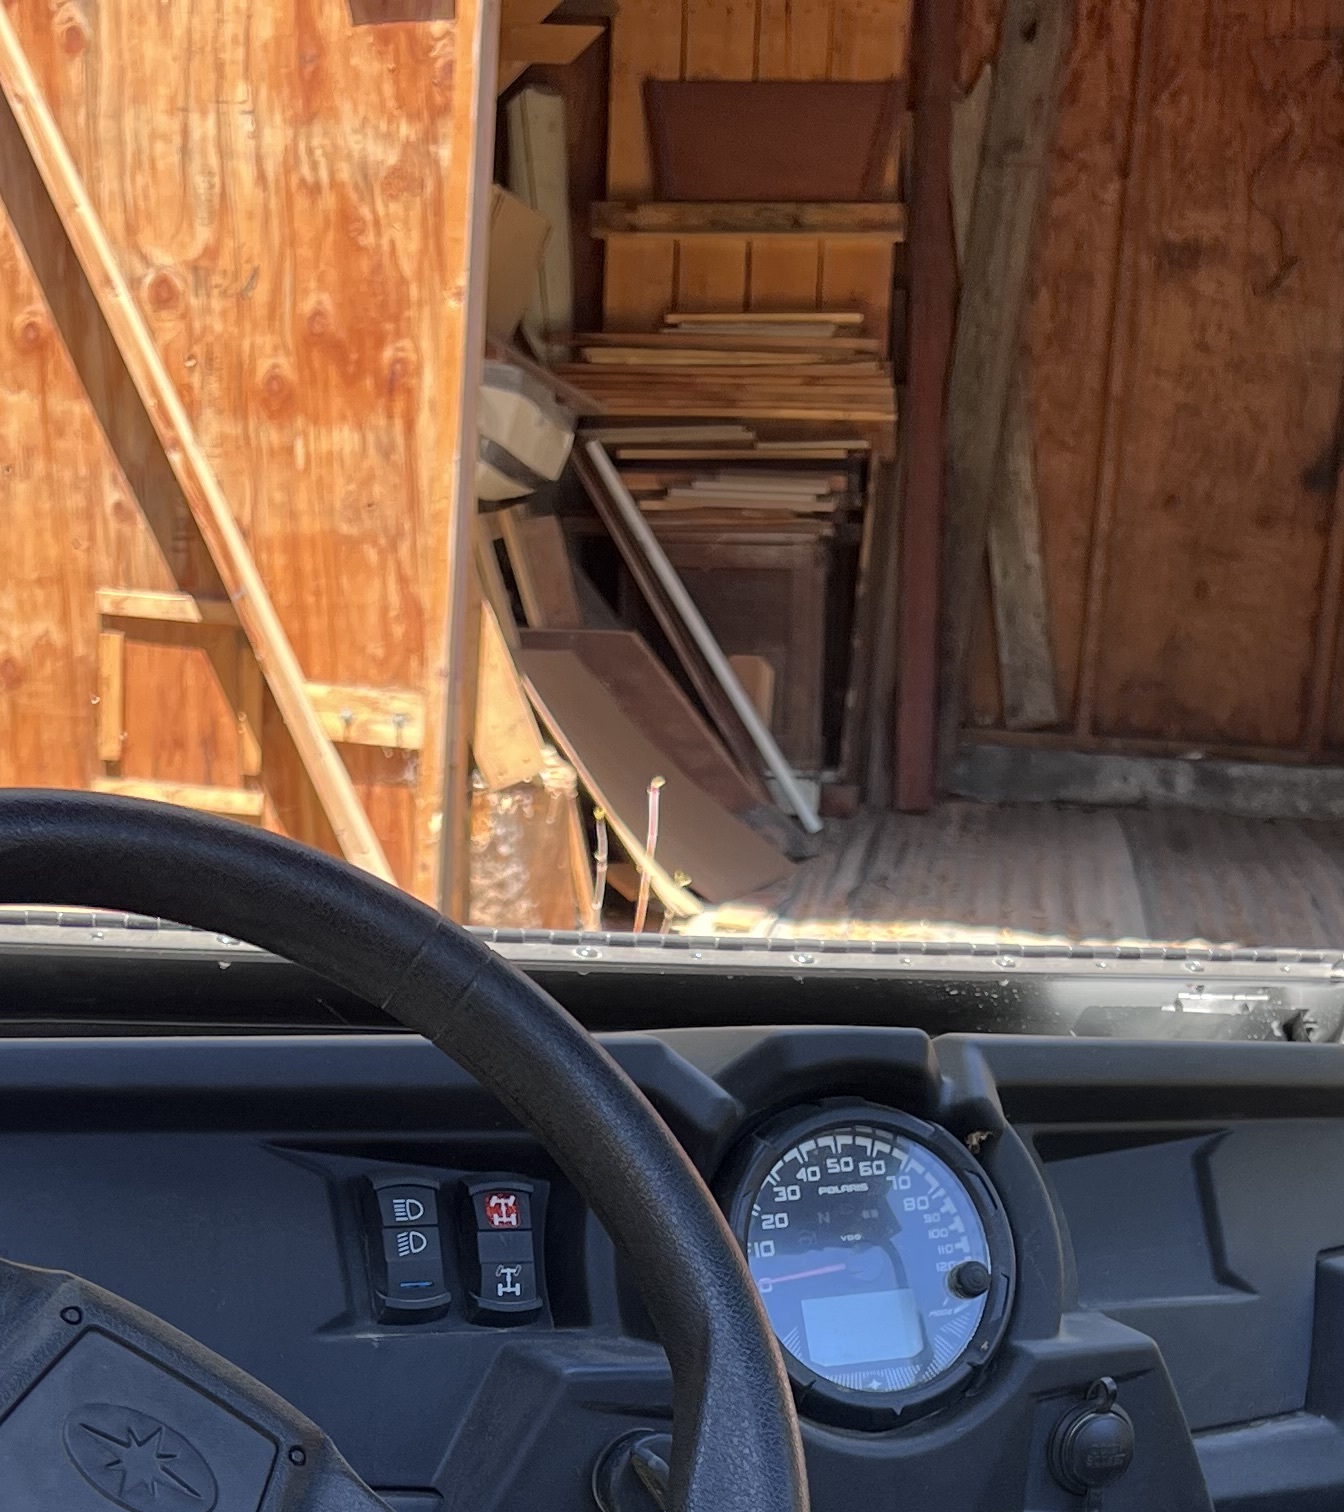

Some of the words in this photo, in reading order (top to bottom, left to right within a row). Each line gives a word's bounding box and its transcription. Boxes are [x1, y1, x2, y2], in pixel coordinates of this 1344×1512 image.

[826, 1157, 854, 1173] 50
[858, 1160, 886, 1177] 60
[796, 1166, 821, 1182] 40
[818, 1183, 869, 1195] POLARIS
[886, 1175, 911, 1191] 70
[773, 1185, 801, 1201] 30
[903, 1196, 930, 1211] 80
[761, 1213, 789, 1230] 20
[817, 1212, 831, 1225] N
[923, 1213, 941, 1224] 90
[927, 1228, 949, 1239] 100
[754, 1240, 775, 1258] 10
[937, 1245, 954, 1255] 110
